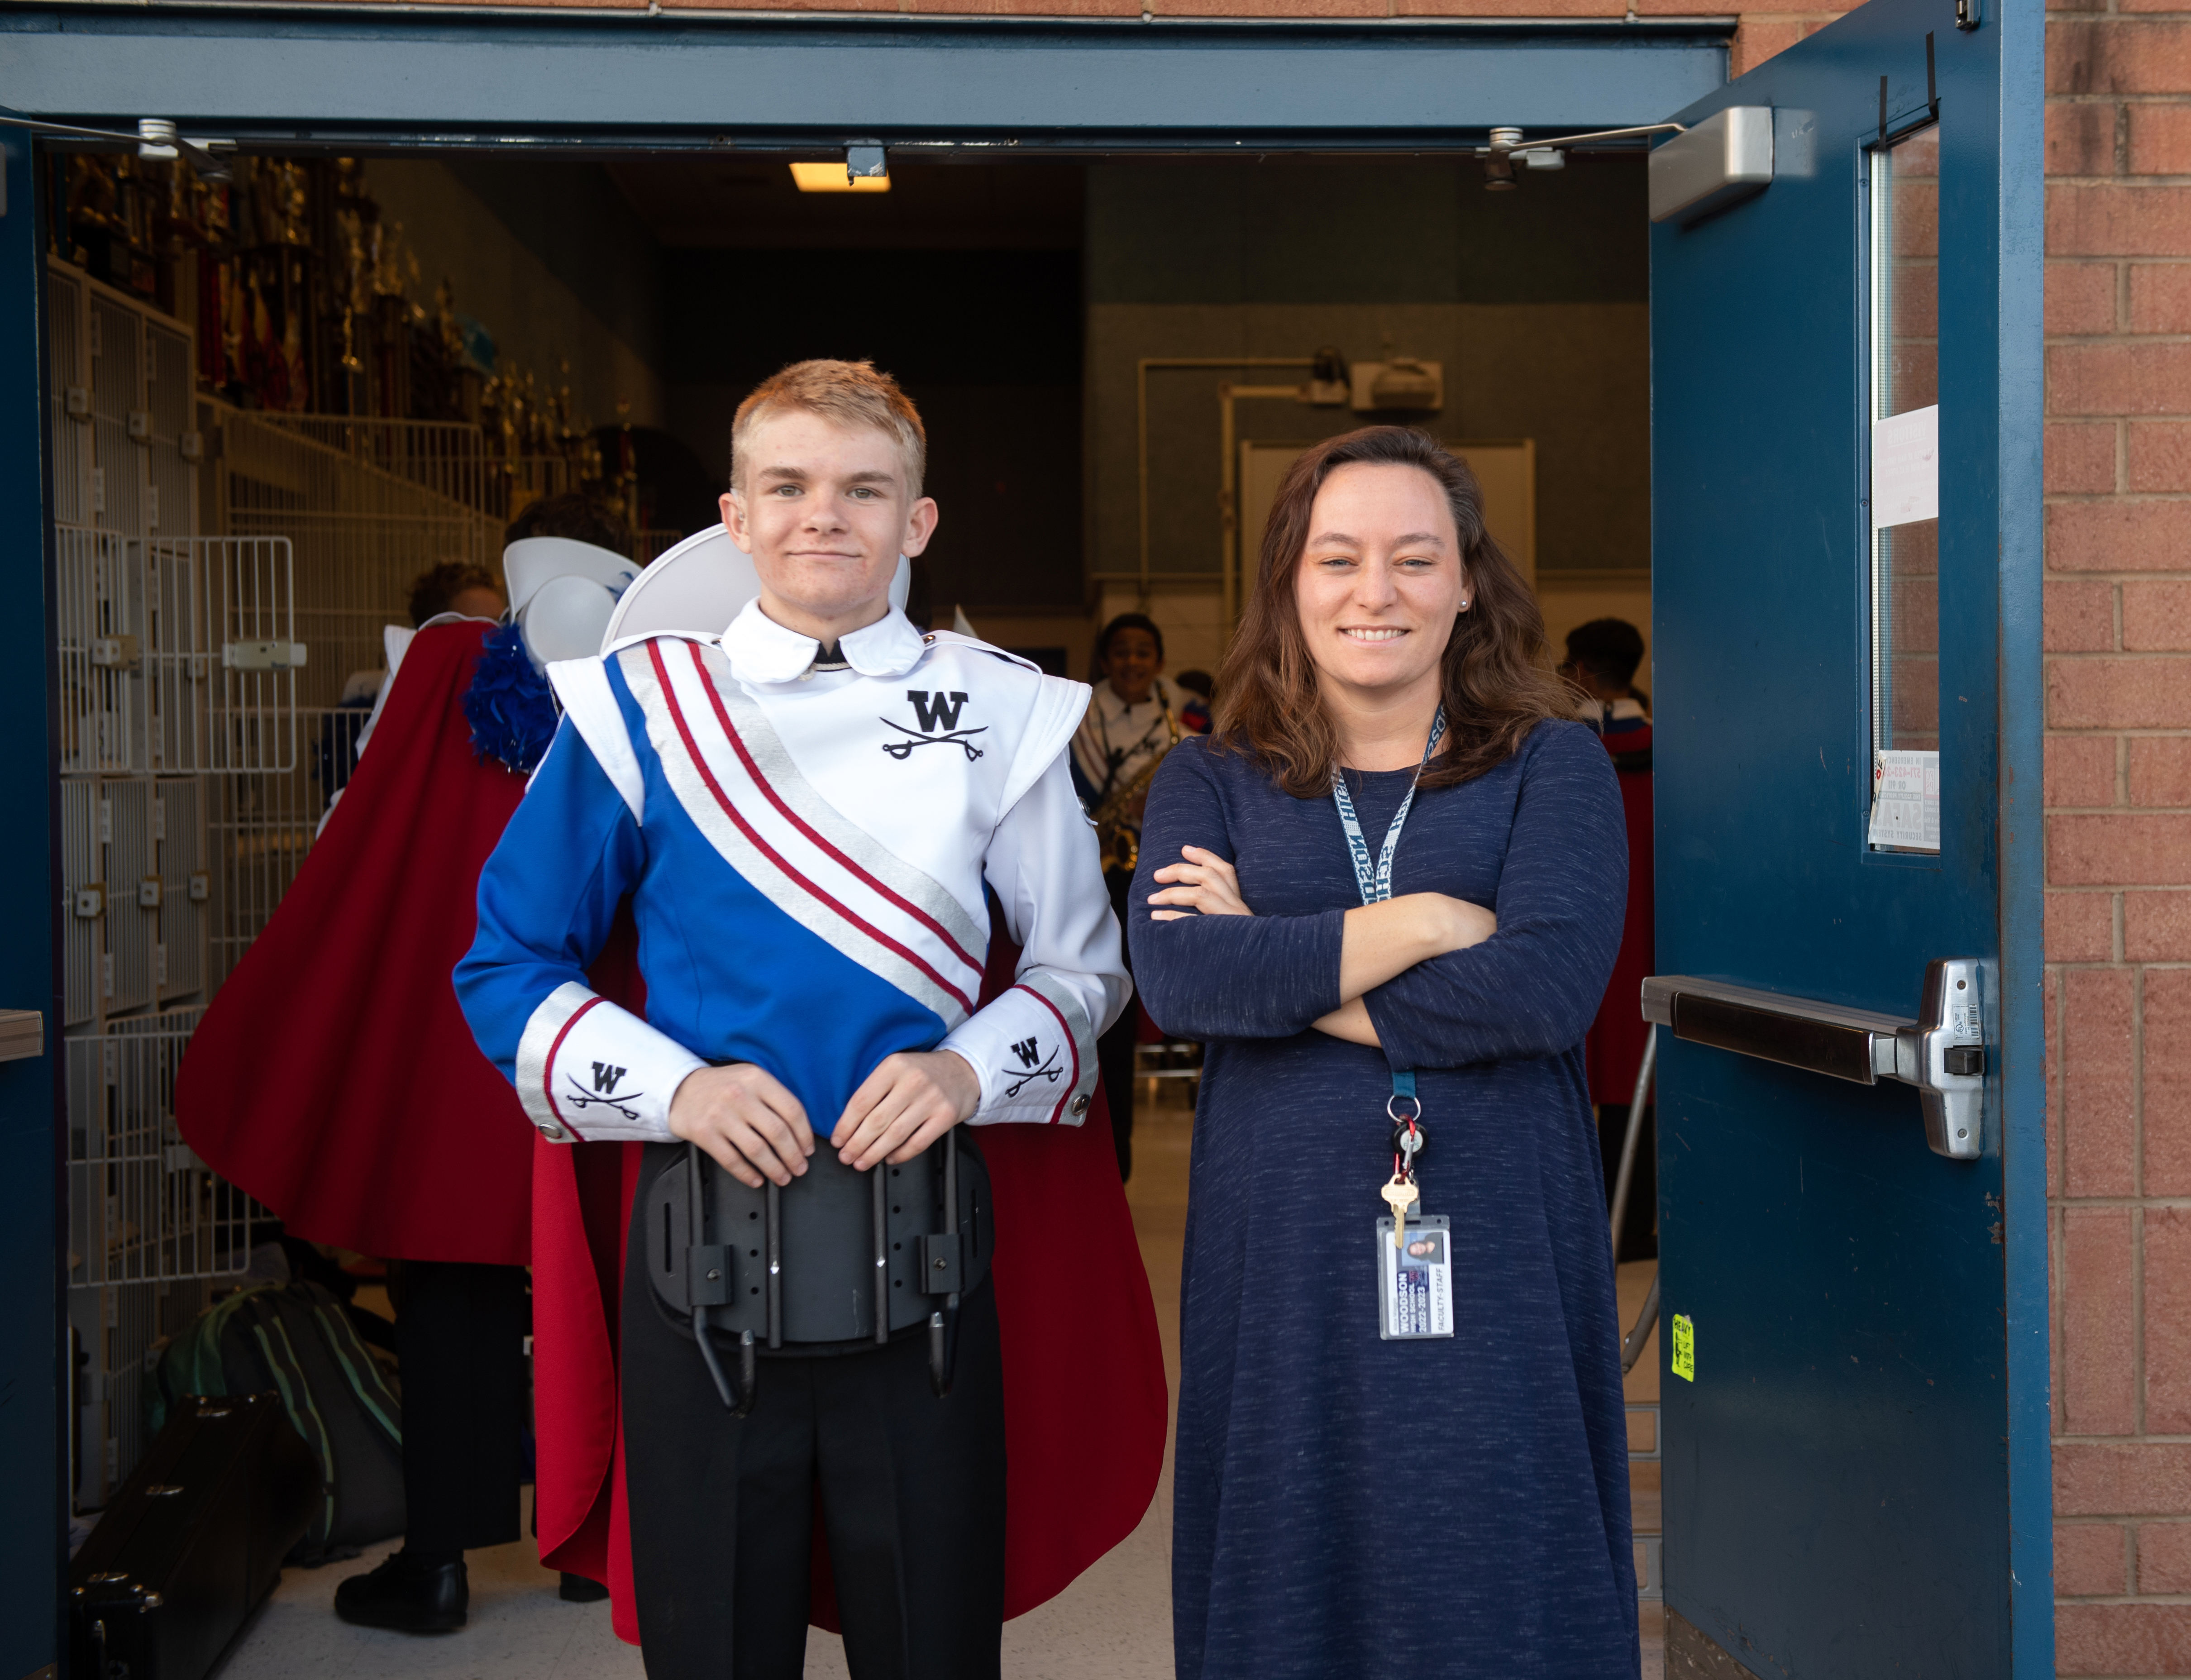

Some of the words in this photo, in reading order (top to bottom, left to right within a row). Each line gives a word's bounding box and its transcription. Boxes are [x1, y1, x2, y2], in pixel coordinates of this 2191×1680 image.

[907, 690, 969, 732] W
[1010, 1036, 1040, 1069] W
[592, 1061, 627, 1094] W
[1398, 1273, 1409, 1333] WOODSON
[1417, 1286, 1427, 1333] 2022-2023
[1436, 1268, 1445, 1331] FACULTY-STAFF
